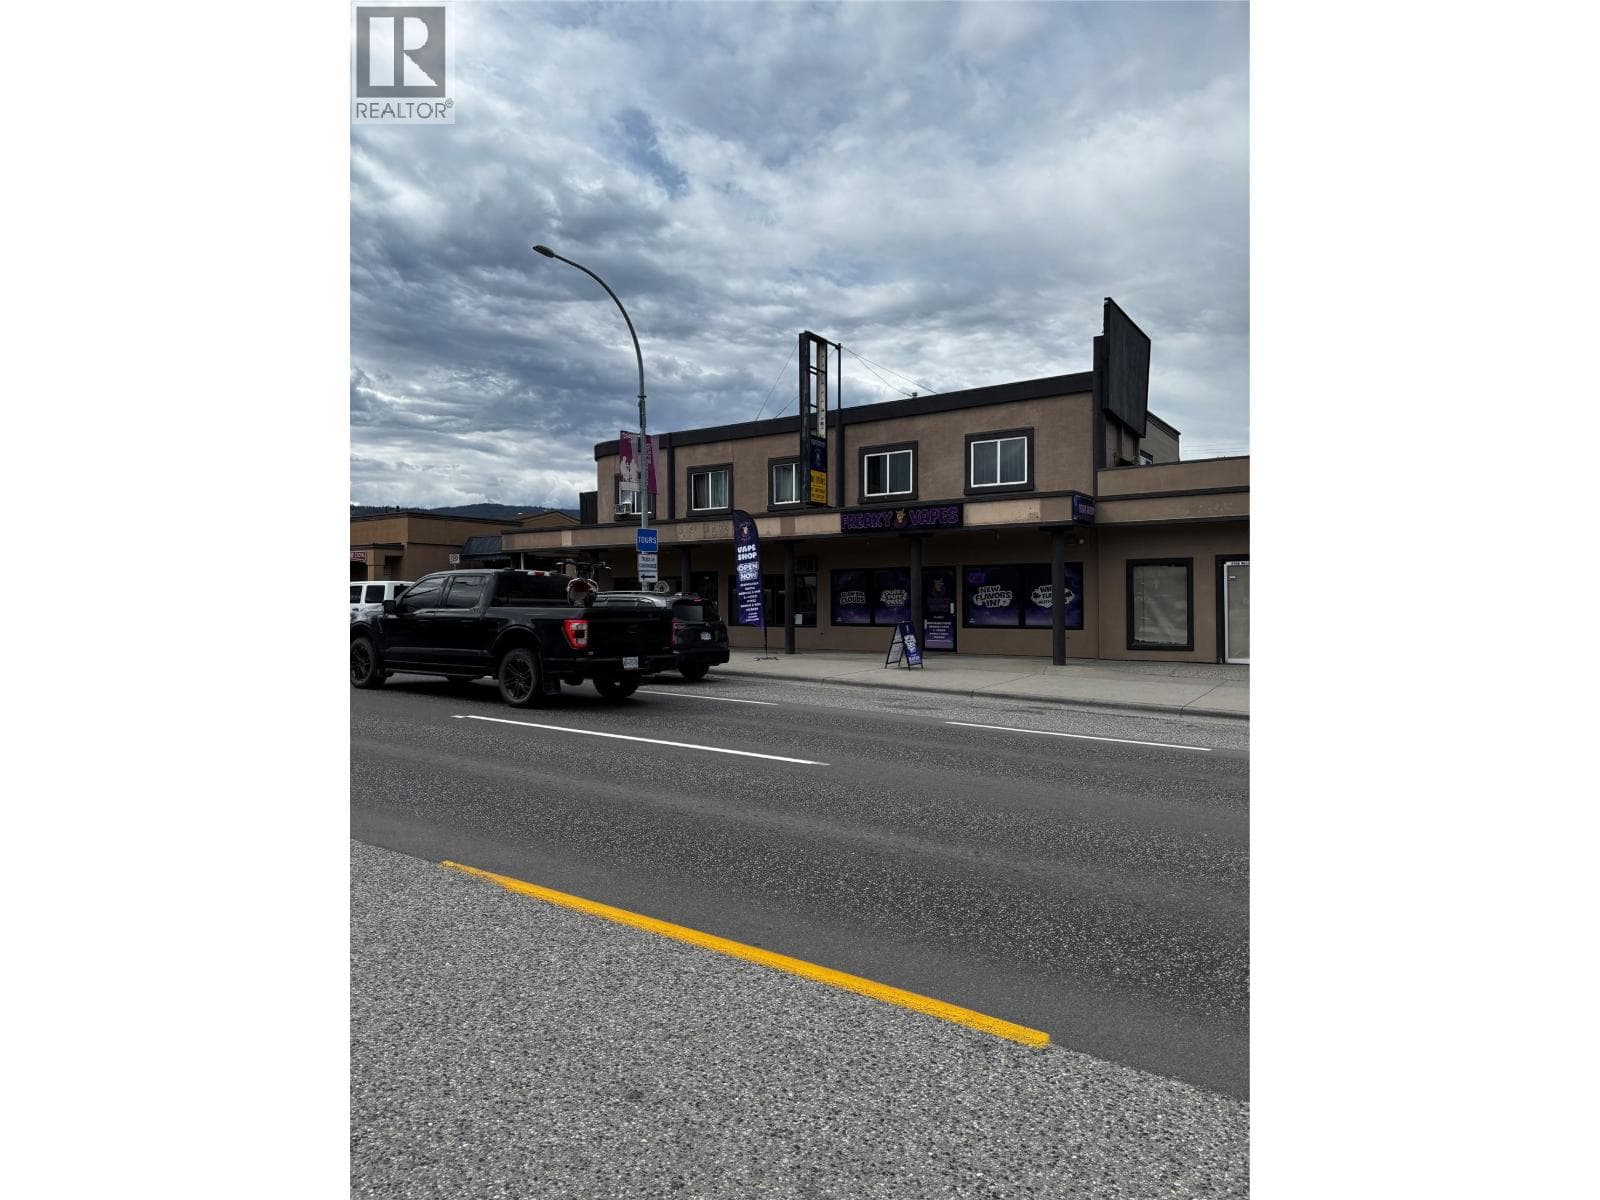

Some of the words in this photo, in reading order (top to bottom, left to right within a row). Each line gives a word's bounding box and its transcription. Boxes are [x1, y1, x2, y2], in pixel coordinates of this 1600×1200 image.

[842, 511, 893, 530] FREAKY
[908, 506, 960, 525] VAPES
[638, 536, 657, 544] TOURS
[737, 544, 756, 553] VAPE
[737, 551, 758, 561] SHOP
[738, 562, 759, 572] OPEN
[740, 571, 758, 580] NOW
[979, 585, 1000, 594] NEW
[841, 596, 865, 604] CLOUDS
[975, 591, 1012, 602] FLAVORS
